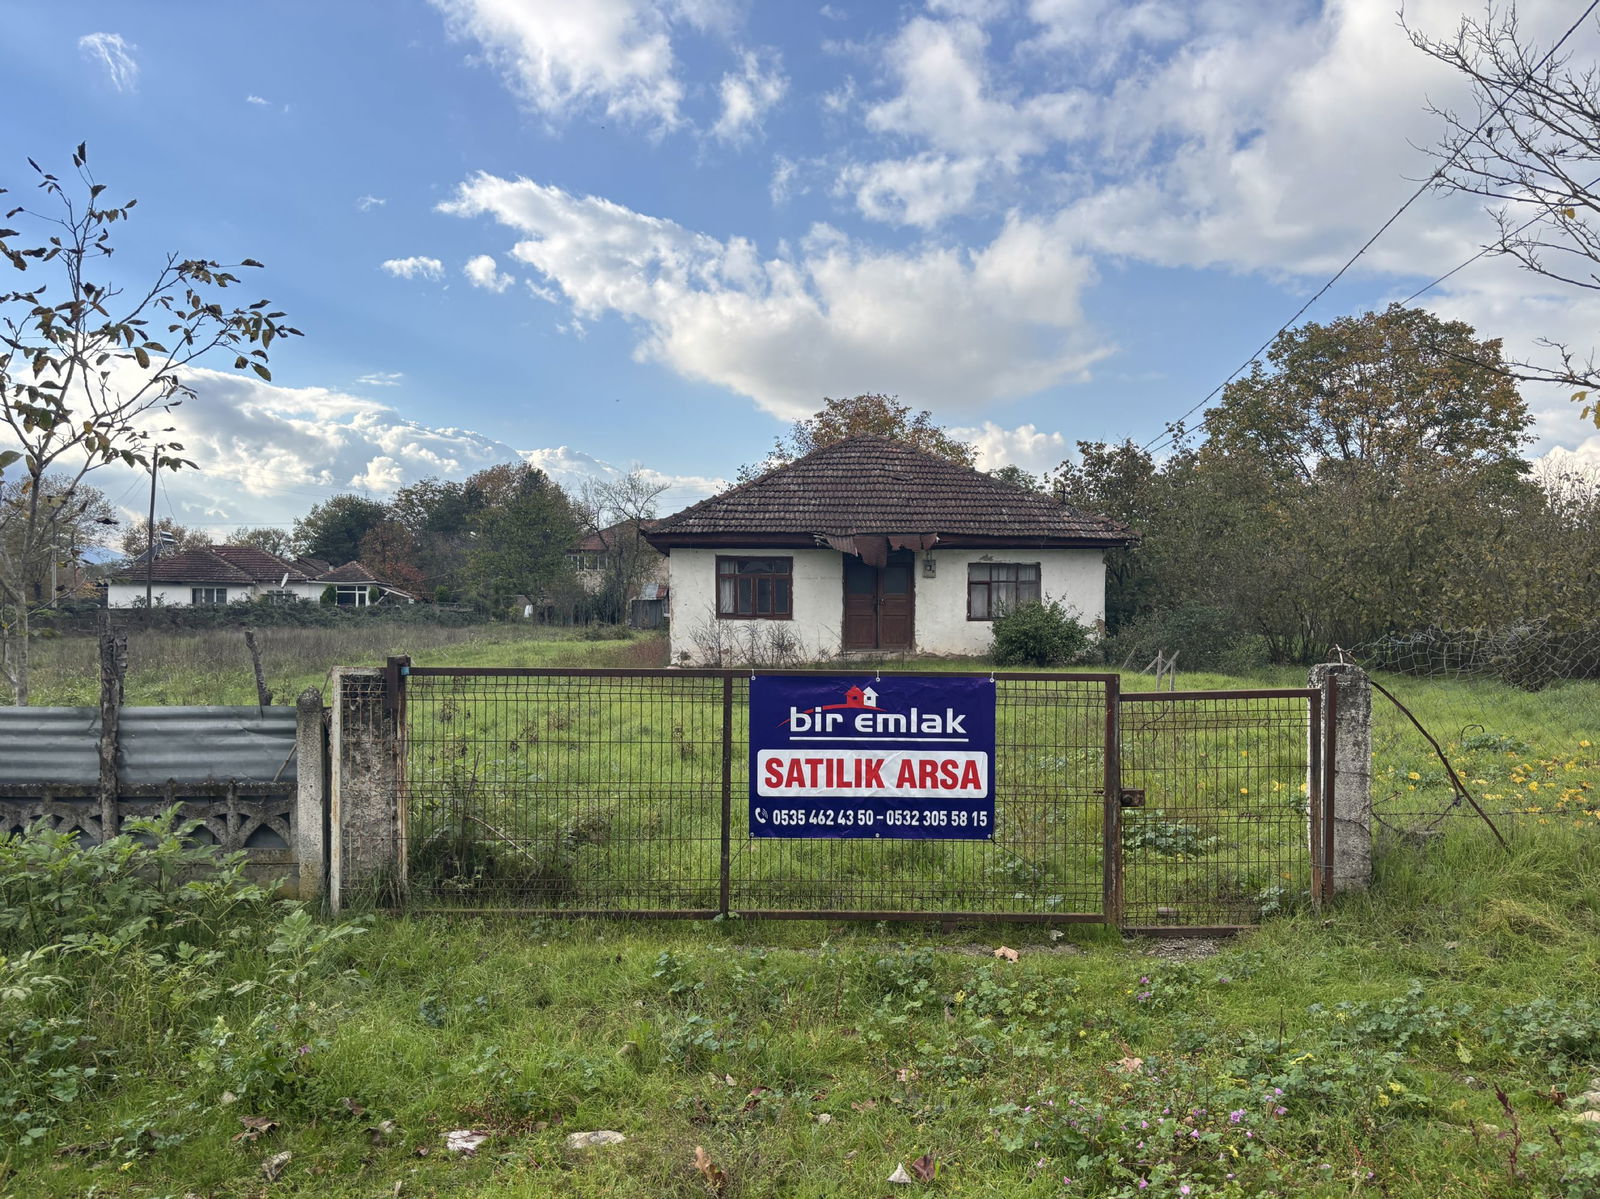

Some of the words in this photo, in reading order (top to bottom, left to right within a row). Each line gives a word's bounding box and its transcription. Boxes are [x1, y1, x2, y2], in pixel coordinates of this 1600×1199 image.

[790, 707, 843, 732] bir
[854, 708, 967, 733] emlak
[765, 758, 885, 788] SATILIK
[896, 759, 982, 789] ARSA
[773, 810, 805, 825] 0535
[809, 810, 834, 825] 462
[838, 811, 854, 825] 43
[858, 810, 873, 825] 50
[886, 811, 919, 826] 0532
[923, 811, 947, 826] 305
[951, 811, 967, 826] 58
[972, 812, 987, 826] 15
